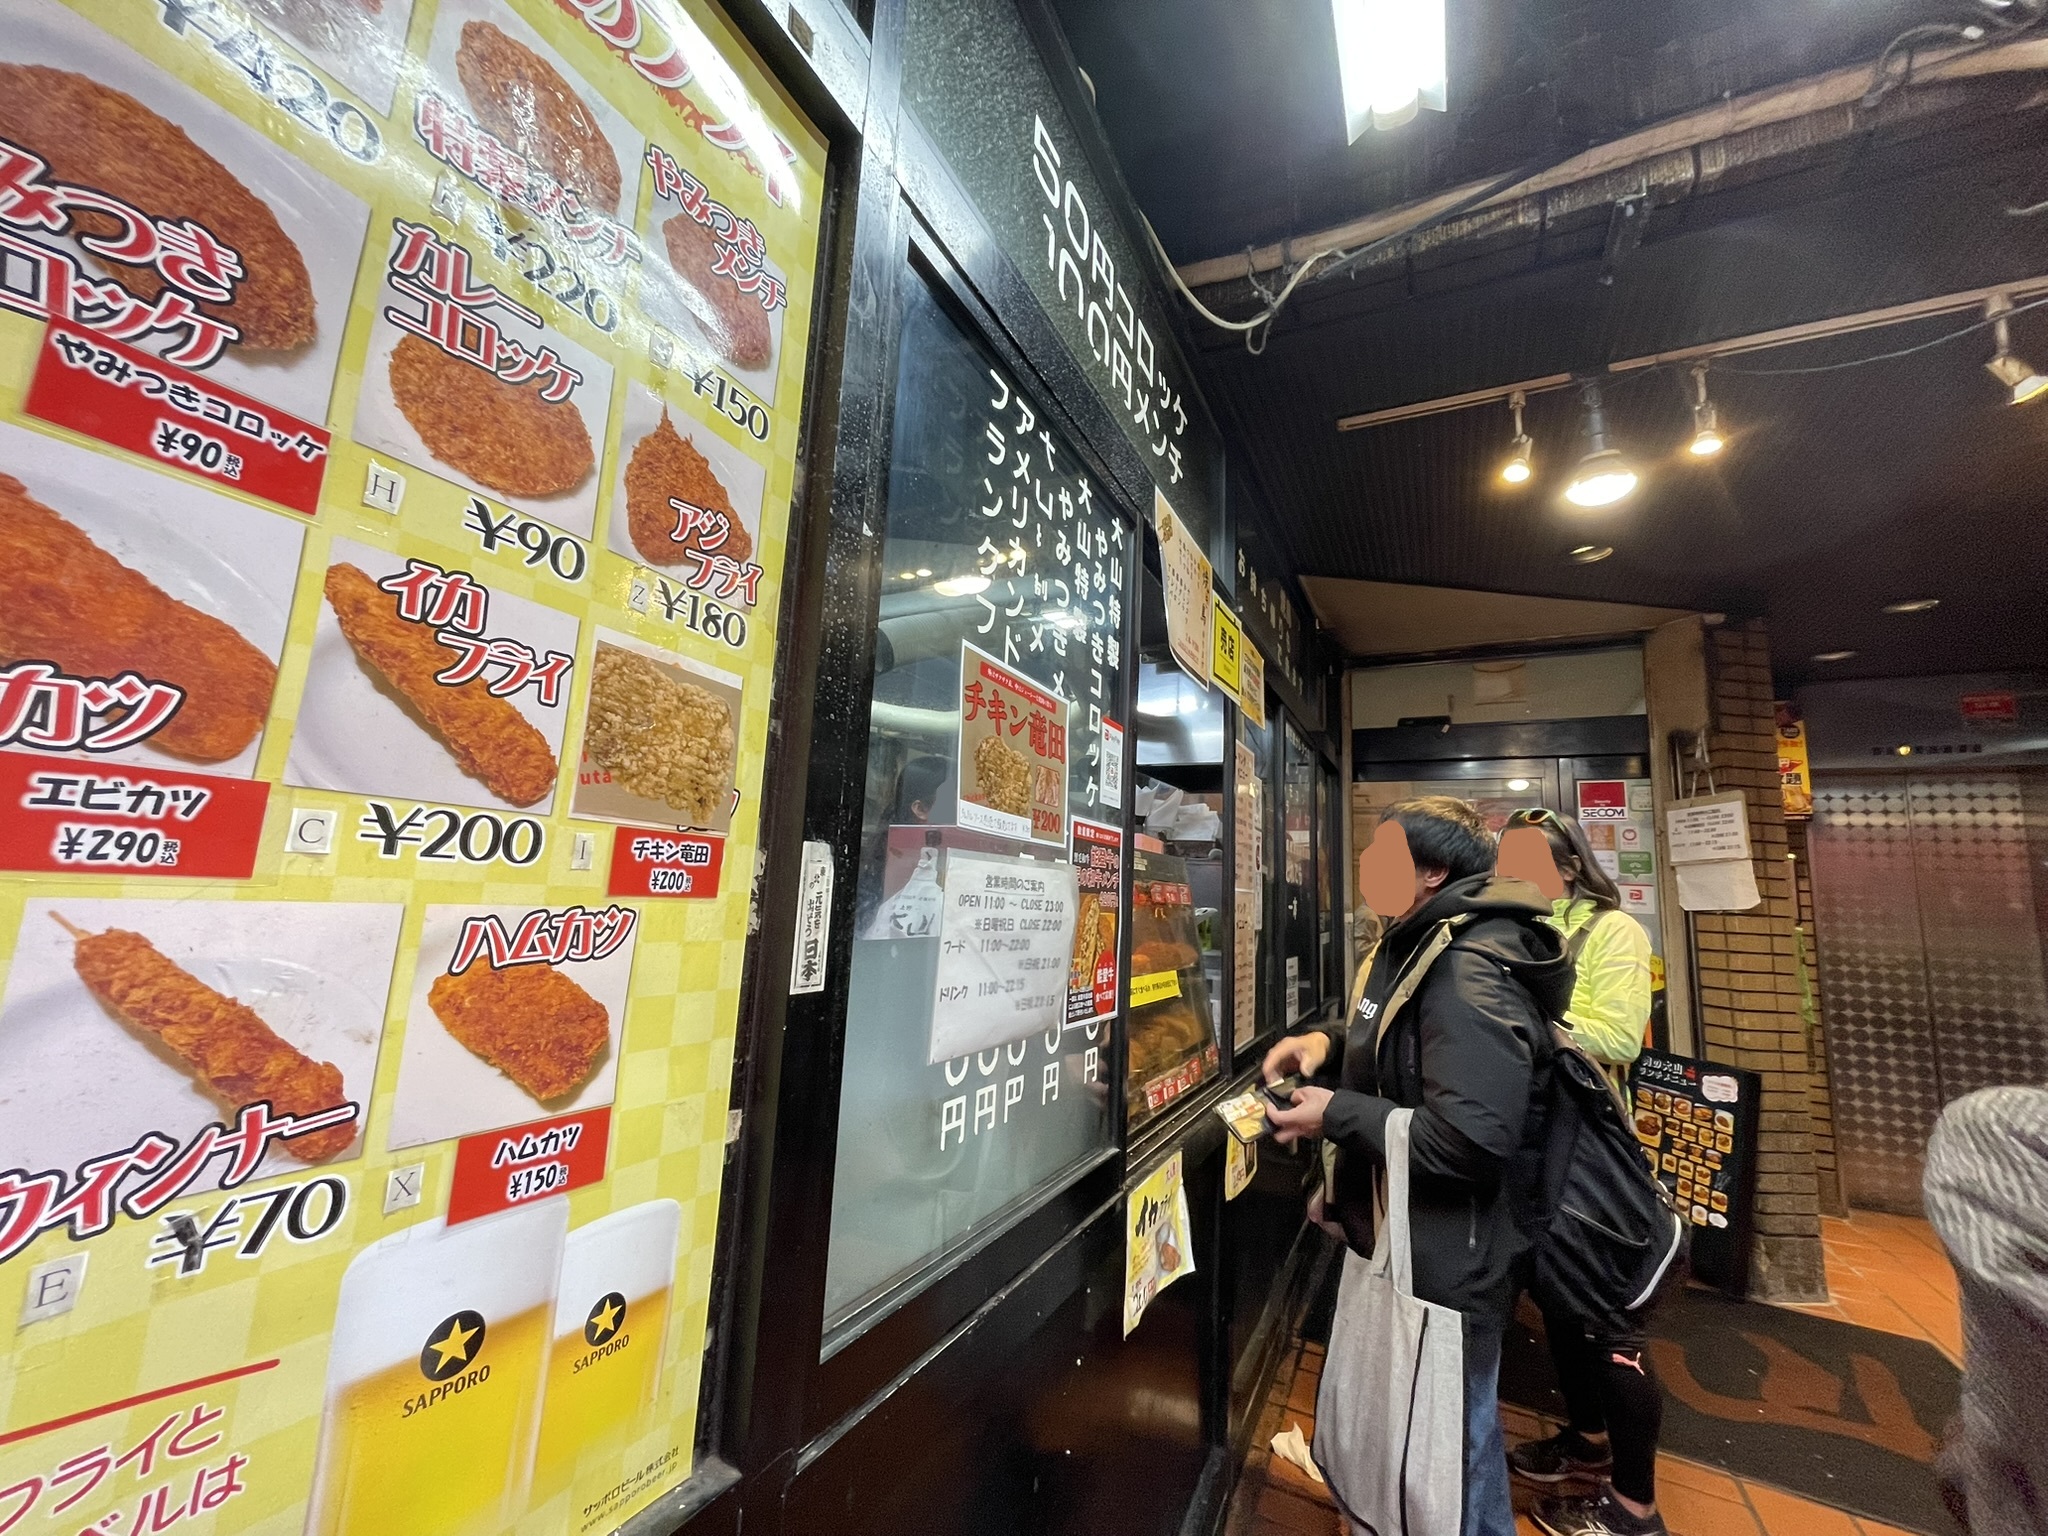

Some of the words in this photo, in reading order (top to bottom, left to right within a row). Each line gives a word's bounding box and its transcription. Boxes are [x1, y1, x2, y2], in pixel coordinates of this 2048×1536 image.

[646, 143, 766, 266] やみつき
[393, 218, 544, 329] カレー
[711, 240, 788, 310] メンチ
[384, 274, 584, 402] コロッケ
[55, 333, 325, 459] やみつきコロッケ
[683, 353, 769, 441] ¥150
[156, 422, 223, 469] ¥90
[372, 473, 398, 505] H
[464, 496, 586, 583] ¥90
[668, 498, 732, 551] アジ
[377, 558, 490, 636] イカ
[684, 547, 765, 606] フライ
[654, 578, 747, 648] ¥180
[436, 630, 574, 707] フライ
[1085, 527, 1108, 808] やみつきコロッケ
[965, 680, 1066, 765] チキン竜田
[27, 776, 208, 819] エビカツ
[1031, 808, 1061, 834] ¥200
[1582, 808, 1625, 818] SECOM
[58, 827, 161, 863] ¥290
[297, 818, 325, 846] C
[360, 803, 543, 867] ¥200
[633, 840, 709, 864] チキン竜田
[651, 870, 685, 891] ¥200
[958, 894, 981, 908] OPEN
[984, 895, 1005, 910] 11:00
[1021, 898, 1042, 911] CLOSE
[1045, 900, 1064, 913] 23:00
[985, 873, 1045, 894] 営業時間のご案内
[447, 904, 640, 976] ハムカツ
[943, 940, 966, 954] フード
[1019, 918, 1040, 931] CLOSE
[939, 984, 969, 1002] ドリンク
[492, 1123, 583, 1167] ハムカツ
[0, 1099, 361, 1263] ウインナー
[391, 1172, 415, 1202] X
[509, 1164, 557, 1200] ¥150
[148, 1177, 346, 1275] ¥70
[32, 1268, 72, 1309] E
[573, 1333, 631, 1375] SAPPORO
[401, 1364, 492, 1419] SAPPORO
[0, 1404, 225, 1535] フライと
[580, 1461, 679, 1533] www.sapporobeer.jp
[583, 1445, 680, 1518] サッポロビール株式会社
